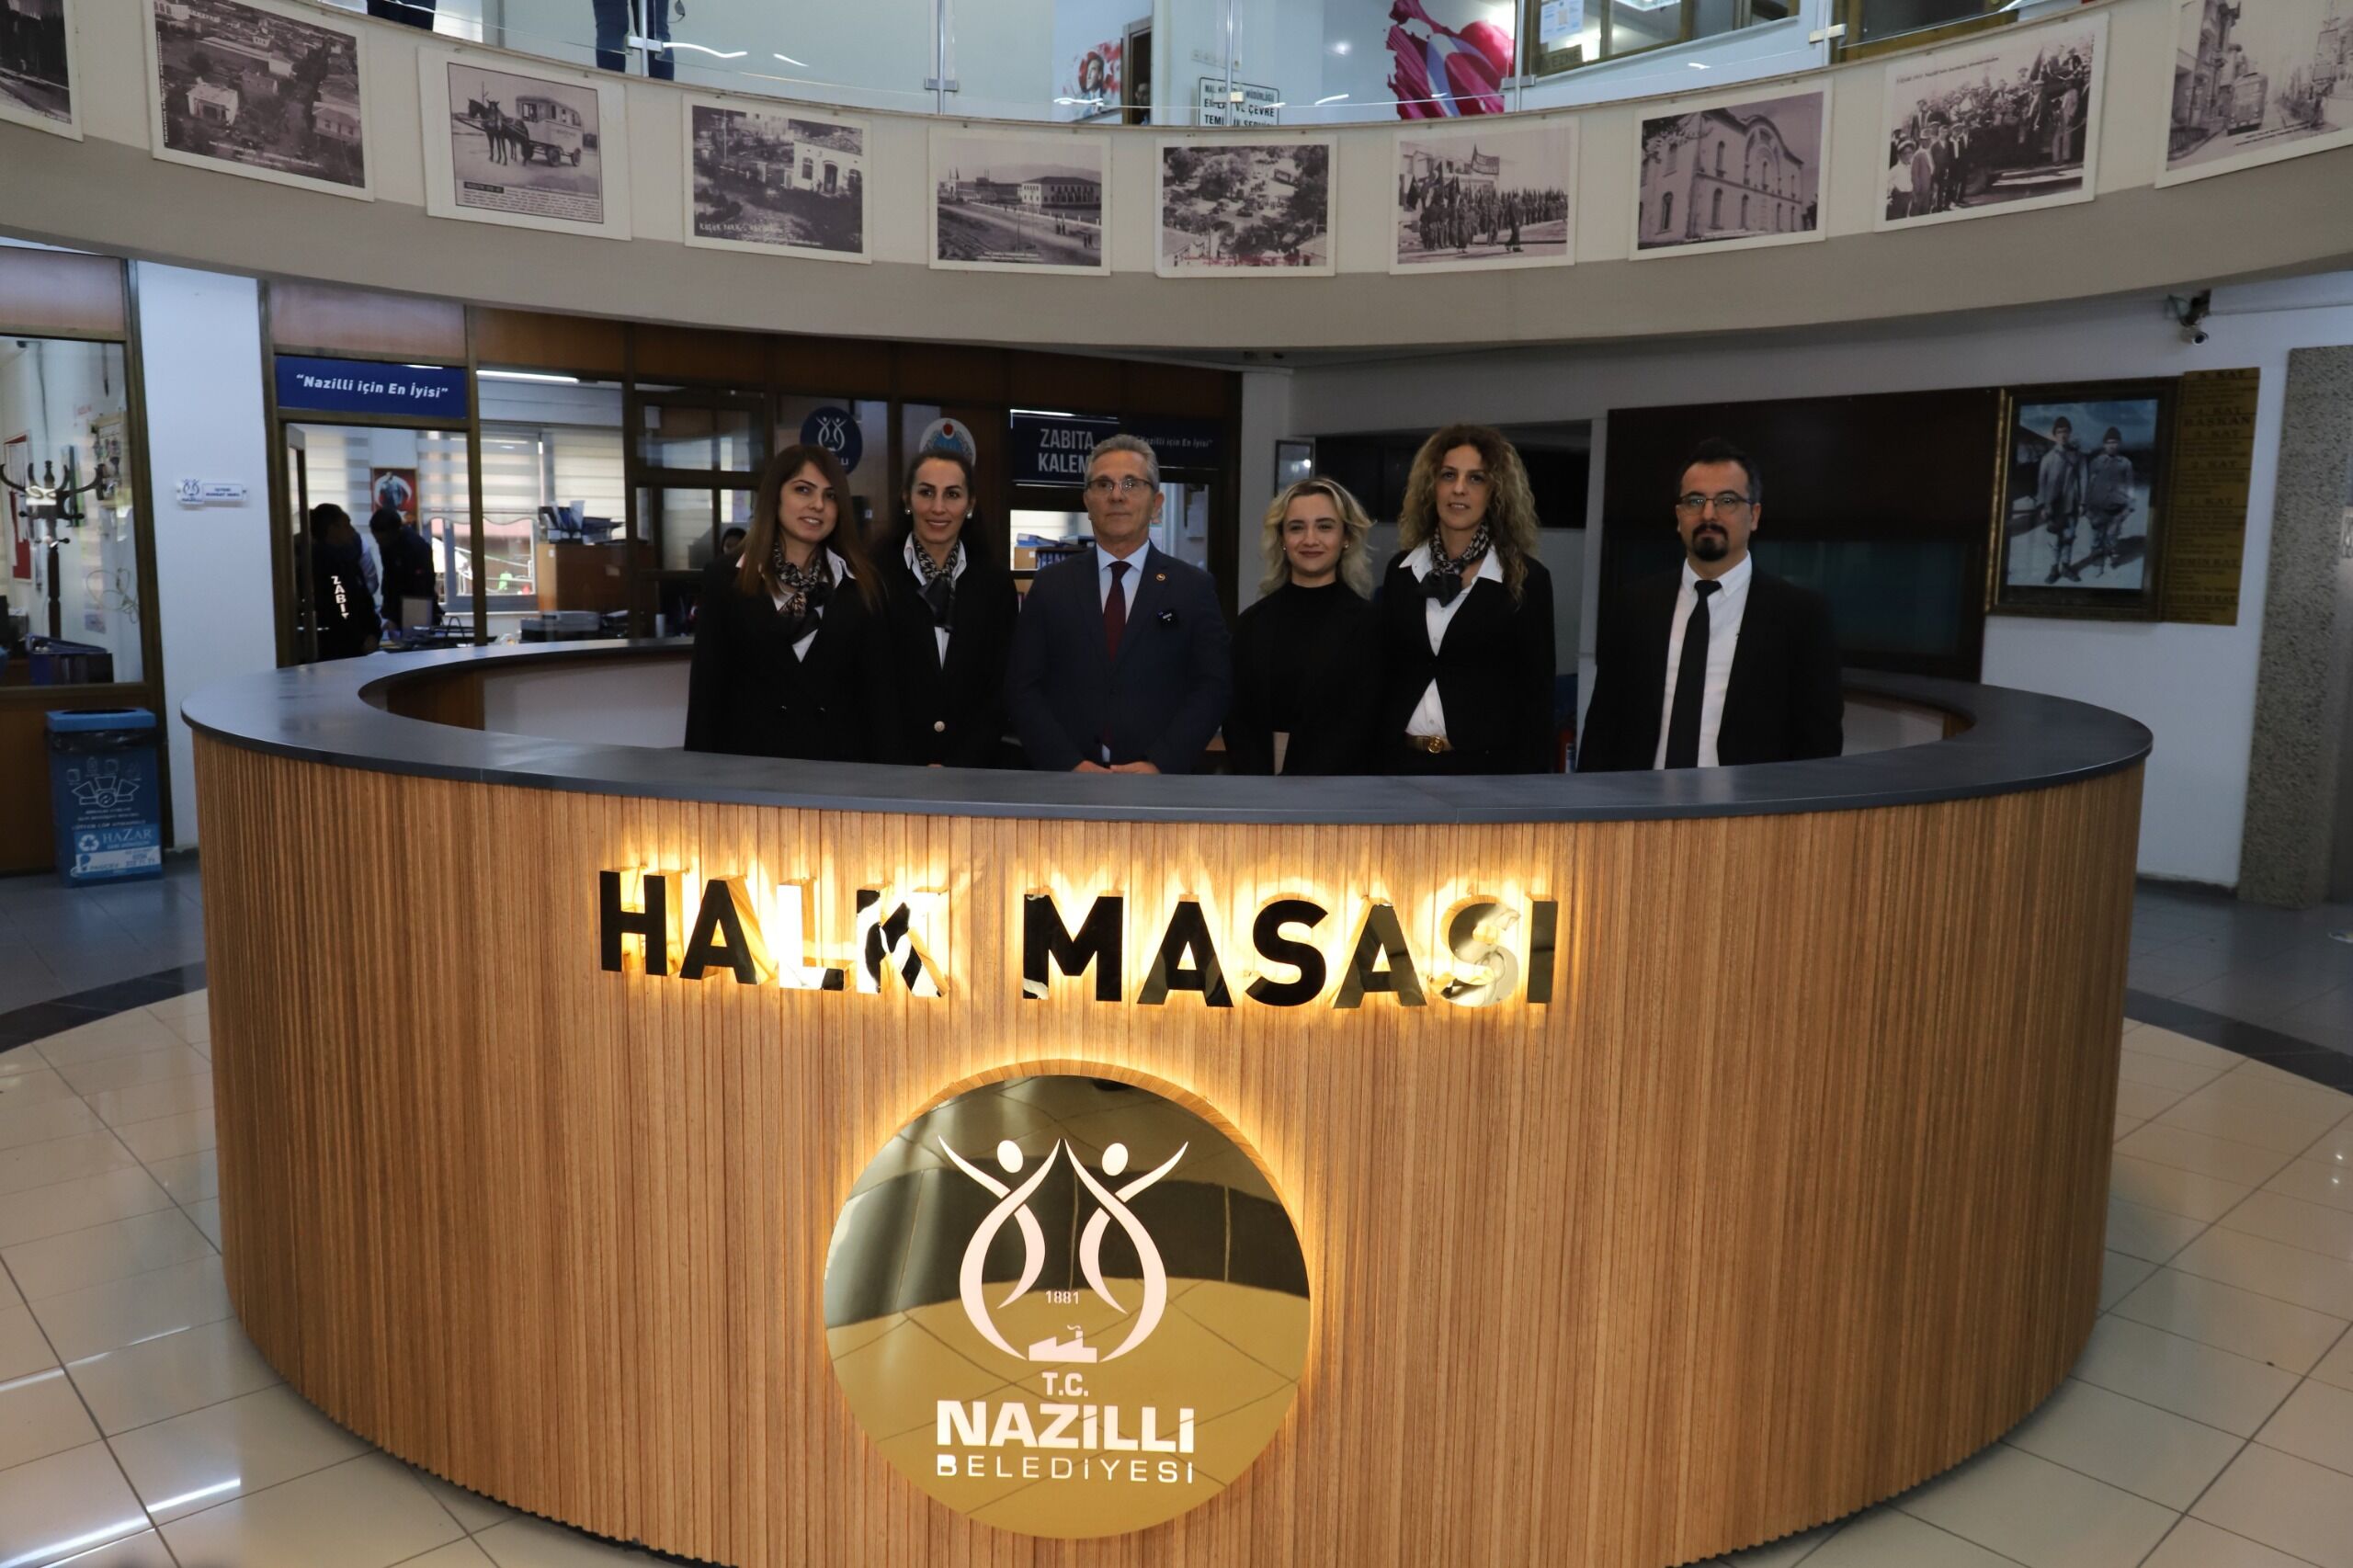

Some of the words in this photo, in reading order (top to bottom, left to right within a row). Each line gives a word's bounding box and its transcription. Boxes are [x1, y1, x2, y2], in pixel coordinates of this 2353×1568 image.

[357, 381, 384, 394] için
[388, 382, 405, 395] En
[1039, 427, 1095, 450] ZABITA
[102, 828, 153, 844] HAZAR
[599, 869, 950, 999] HALK
[1022, 892, 1560, 1009] MASASI
[1045, 1290, 1080, 1305] 1881
[1041, 1371, 1089, 1397] T.C.
[936, 1453, 1194, 1484] BELEDİYESİ
